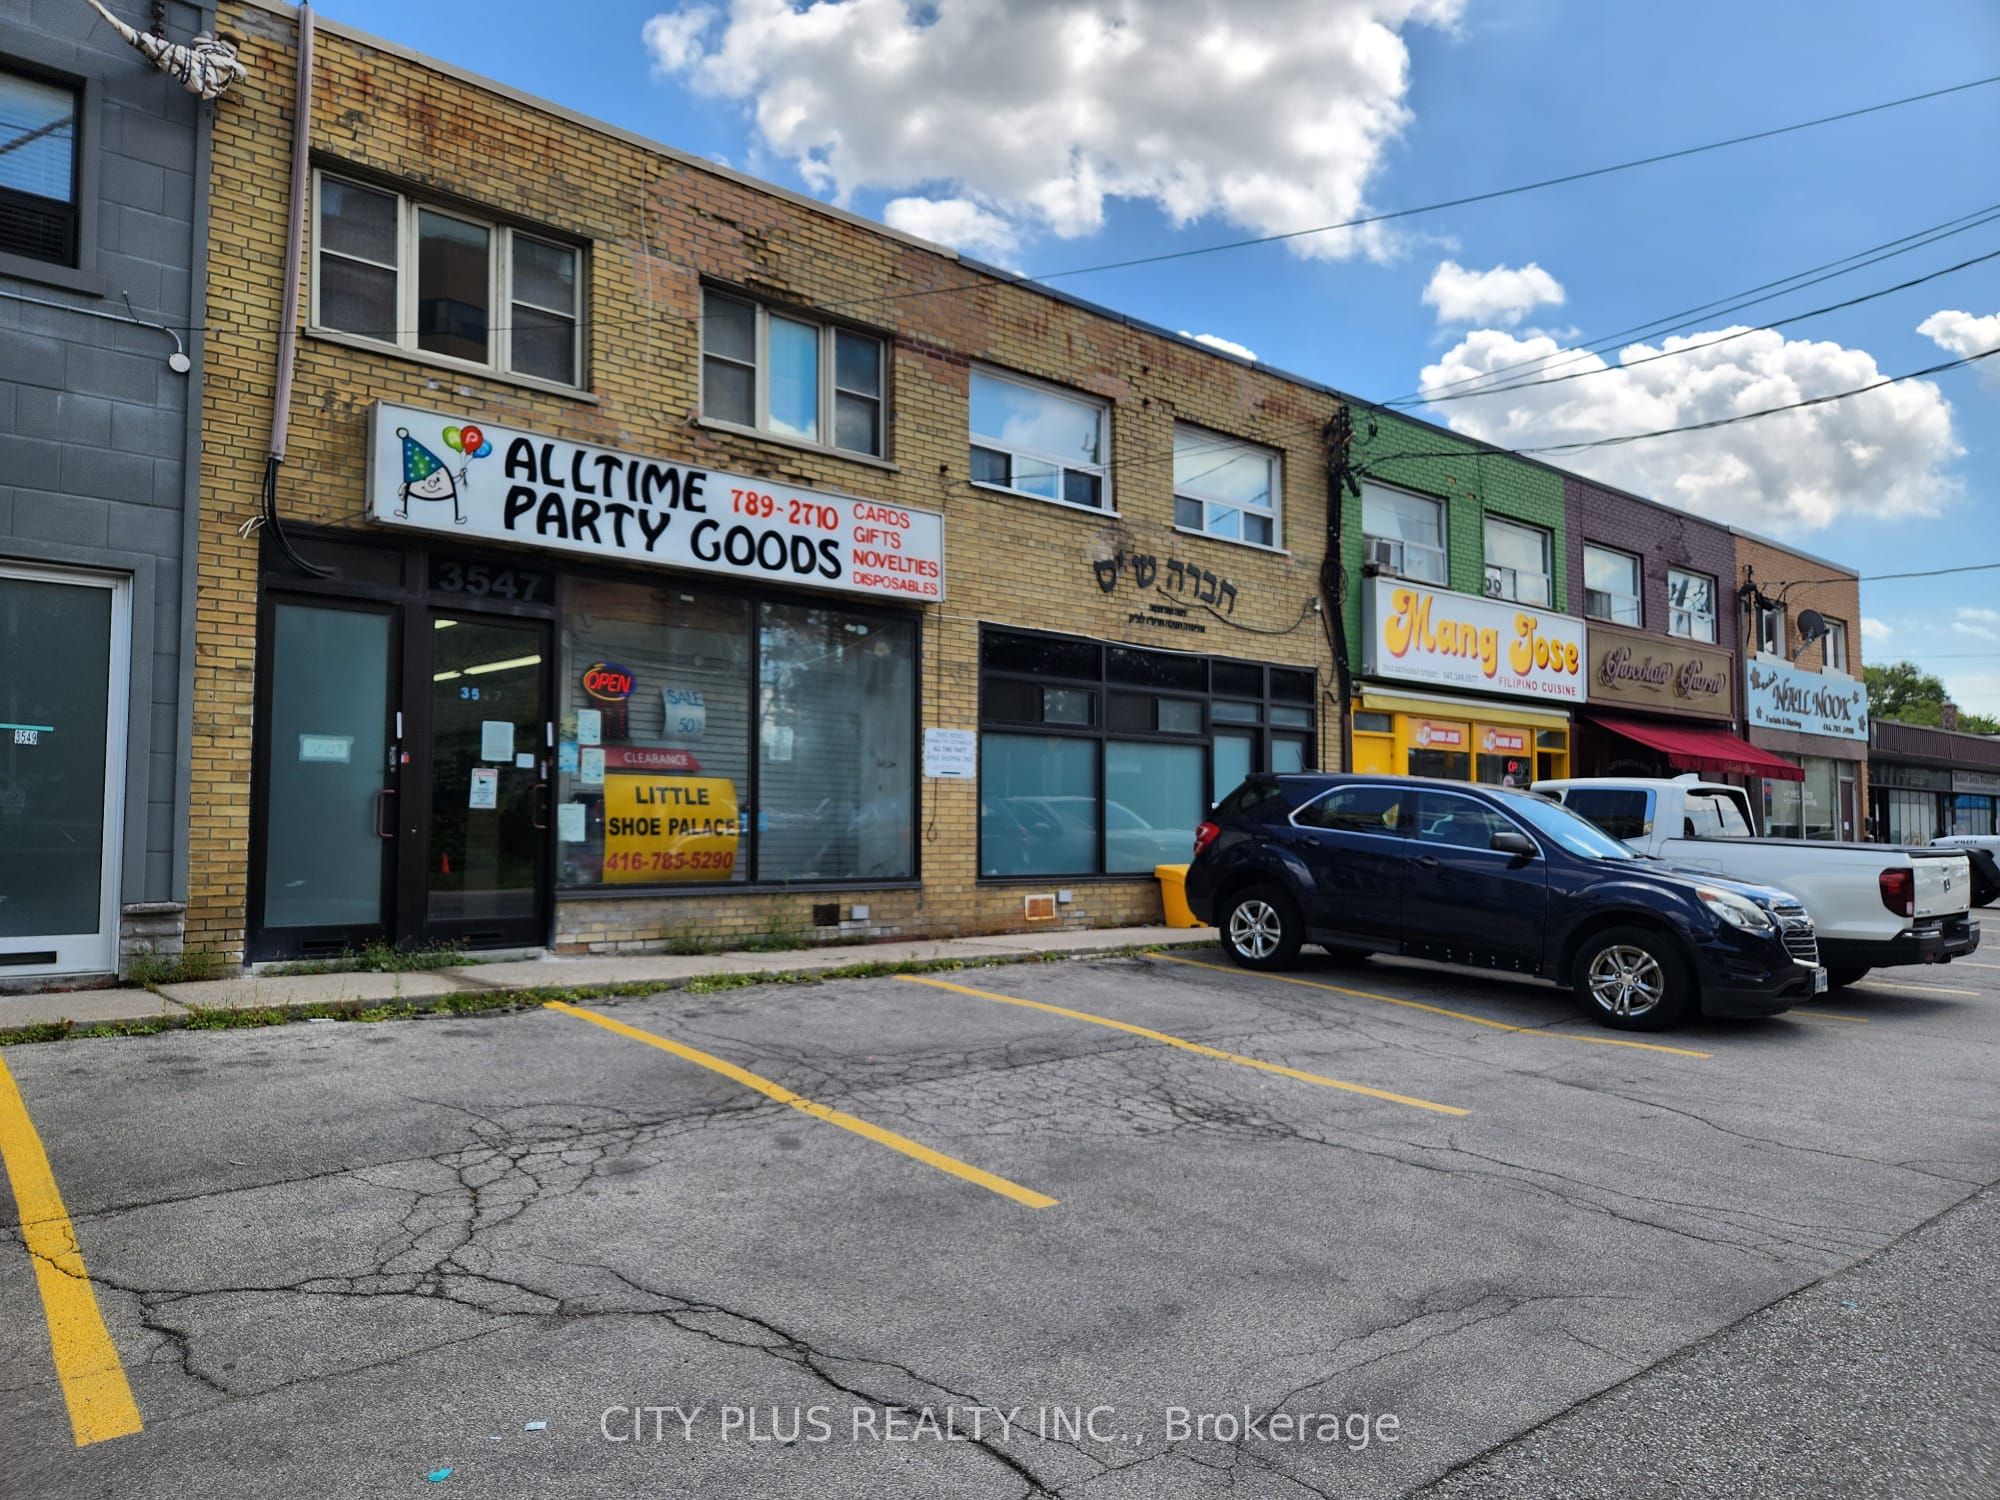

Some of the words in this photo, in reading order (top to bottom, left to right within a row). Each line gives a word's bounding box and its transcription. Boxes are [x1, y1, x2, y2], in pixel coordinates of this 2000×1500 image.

[504, 436, 708, 513] ALLTIME
[730, 488, 839, 530] 789-2710
[852, 502, 911, 530] CARDS
[503, 486, 671, 552] PARTY
[690, 517, 842, 580] GOODS
[852, 526, 902, 550] GIFTS
[852, 548, 940, 578] NOVELTIES
[439, 561, 542, 602] 3547
[852, 571, 939, 596] DISPOSABLES
[1384, 588, 1498, 679] Mang
[1509, 611, 1579, 677] Jose
[586, 671, 632, 693] OPEN
[1498, 676, 1538, 692] FILIPINO
[1542, 683, 1576, 696] CUISINE
[666, 688, 704, 707] SALE
[1812, 684, 1852, 721] NOOK
[624, 752, 688, 766] CLEARANCE
[635, 786, 710, 806] LITTLE
[608, 817, 661, 836] SHOE
[668, 817, 737, 837] PALACE
[606, 852, 734, 872] 416-785-5290
